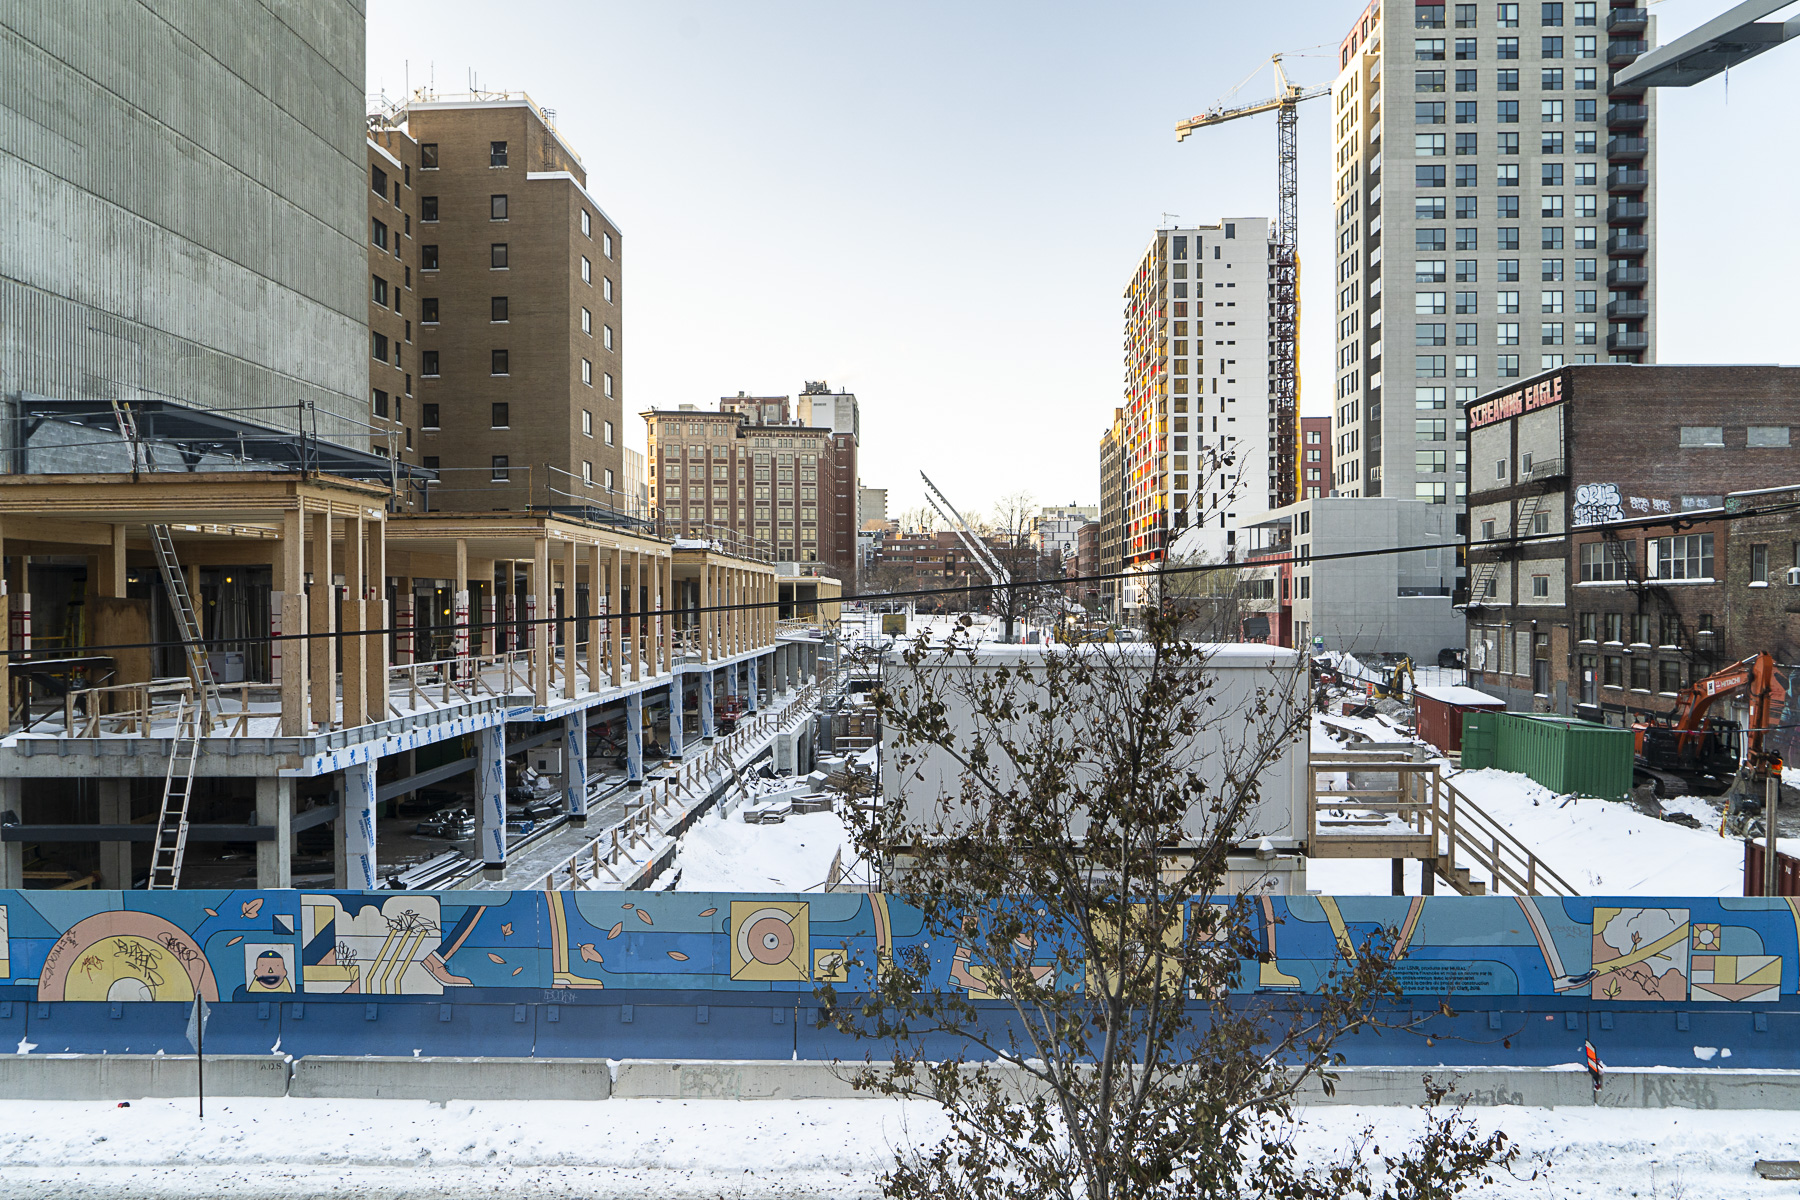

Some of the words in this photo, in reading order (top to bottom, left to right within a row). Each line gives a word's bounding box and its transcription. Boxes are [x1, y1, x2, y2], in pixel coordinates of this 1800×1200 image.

[1470, 390, 1523, 429] SCREAMING
[1525, 376, 1563, 411] EAGLE
[1721, 676, 1741, 688] HITACHI
